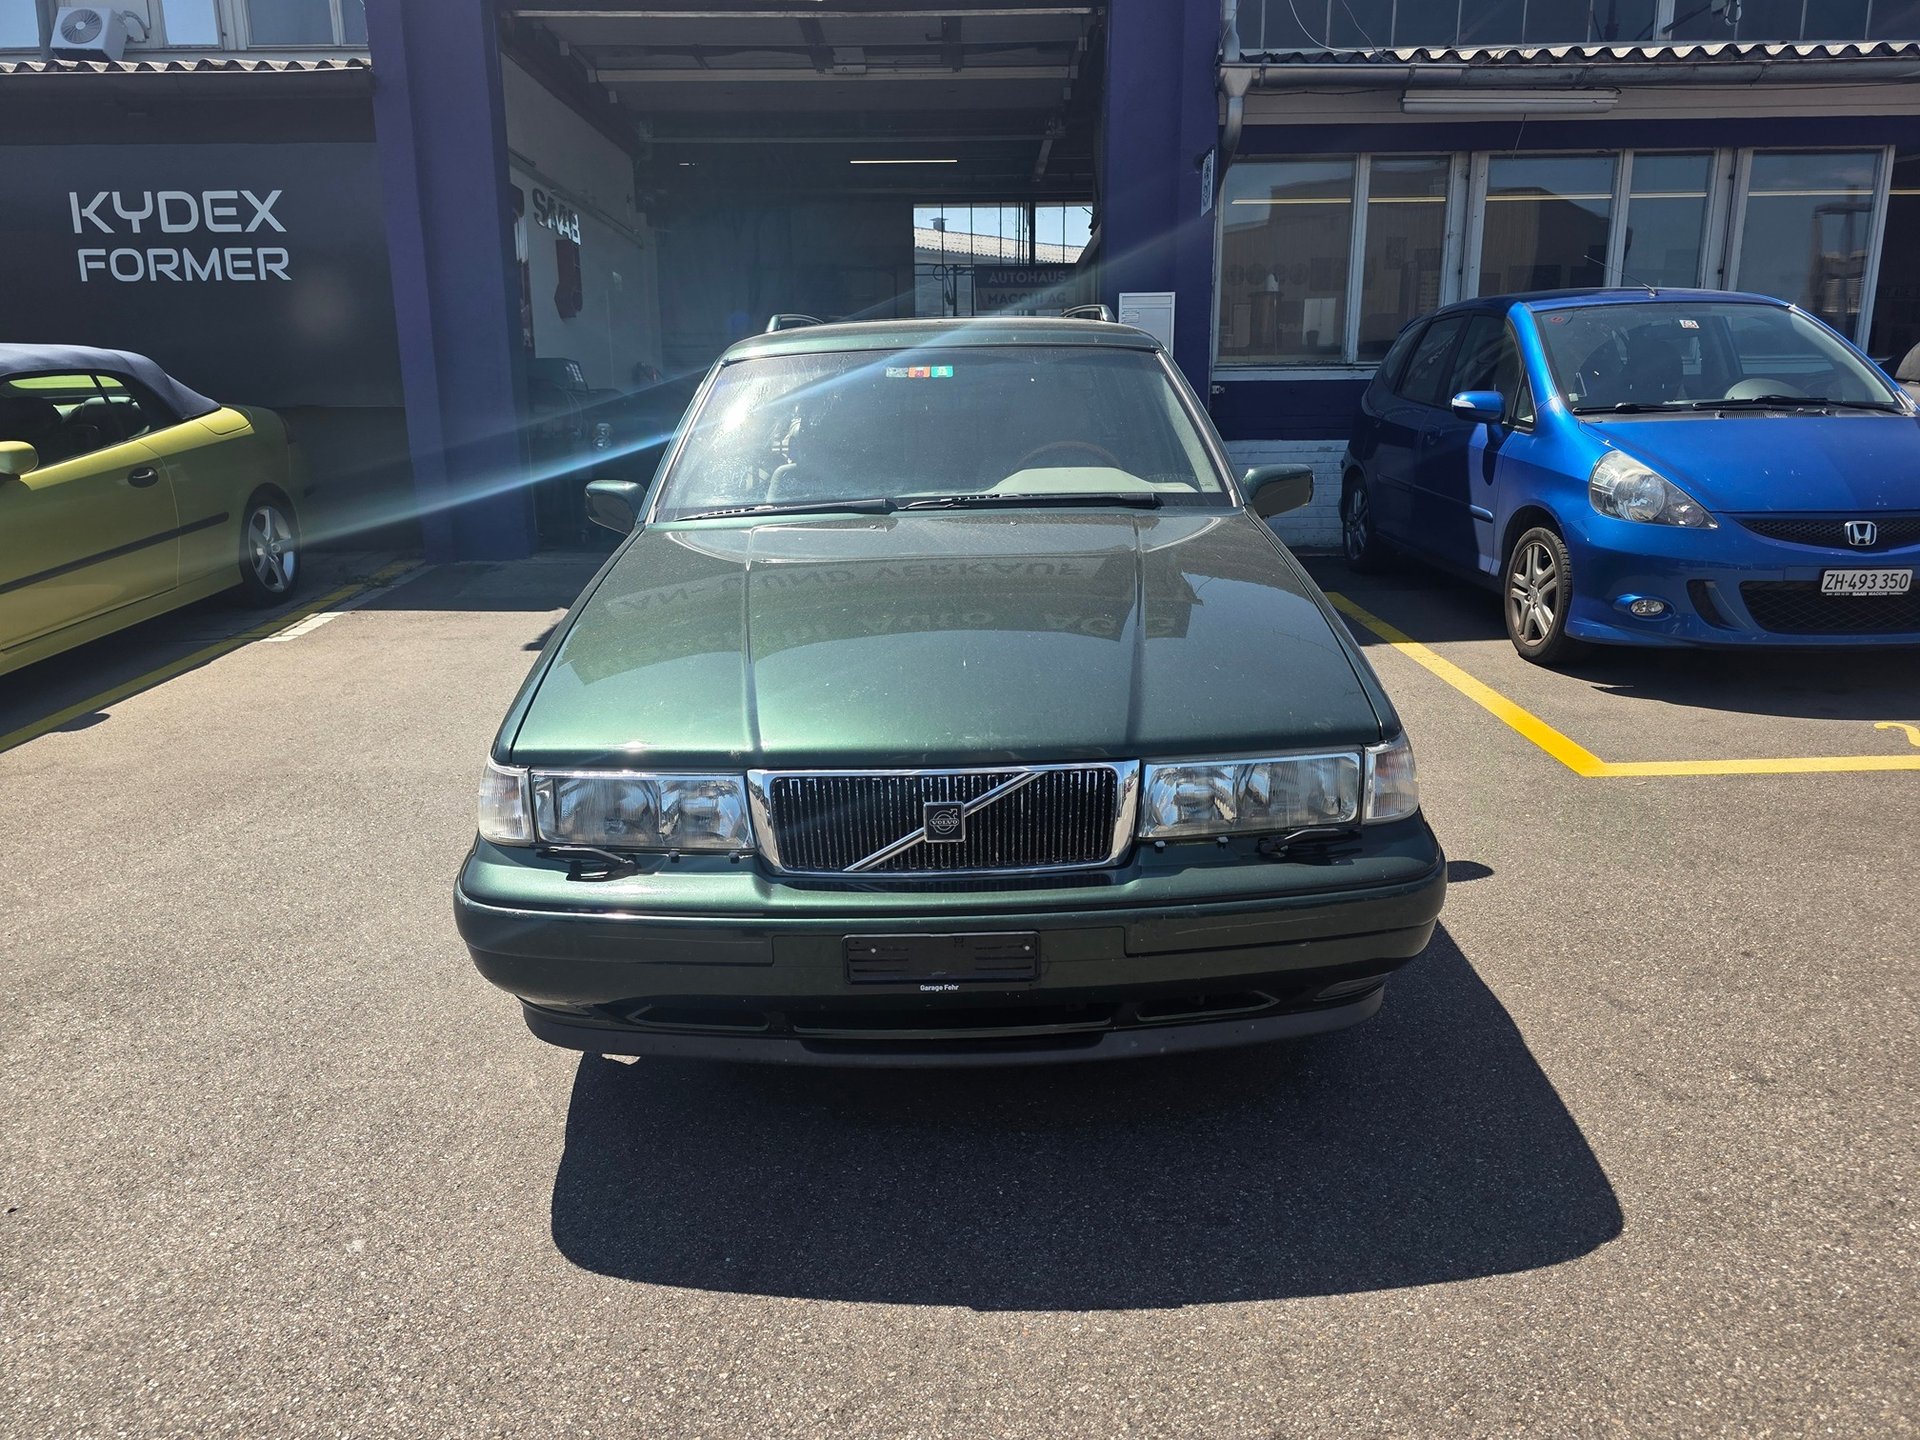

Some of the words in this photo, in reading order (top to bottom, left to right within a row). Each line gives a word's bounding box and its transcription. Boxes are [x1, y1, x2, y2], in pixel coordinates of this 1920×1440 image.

[69, 190, 287, 234] KYDEX
[77, 247, 292, 282] FORMER
[988, 270, 1066, 284] AUTOHAUS
[1048, 292, 1066, 304] AG
[1879, 573, 1909, 589] 350
[920, 984, 944, 992] Garage
